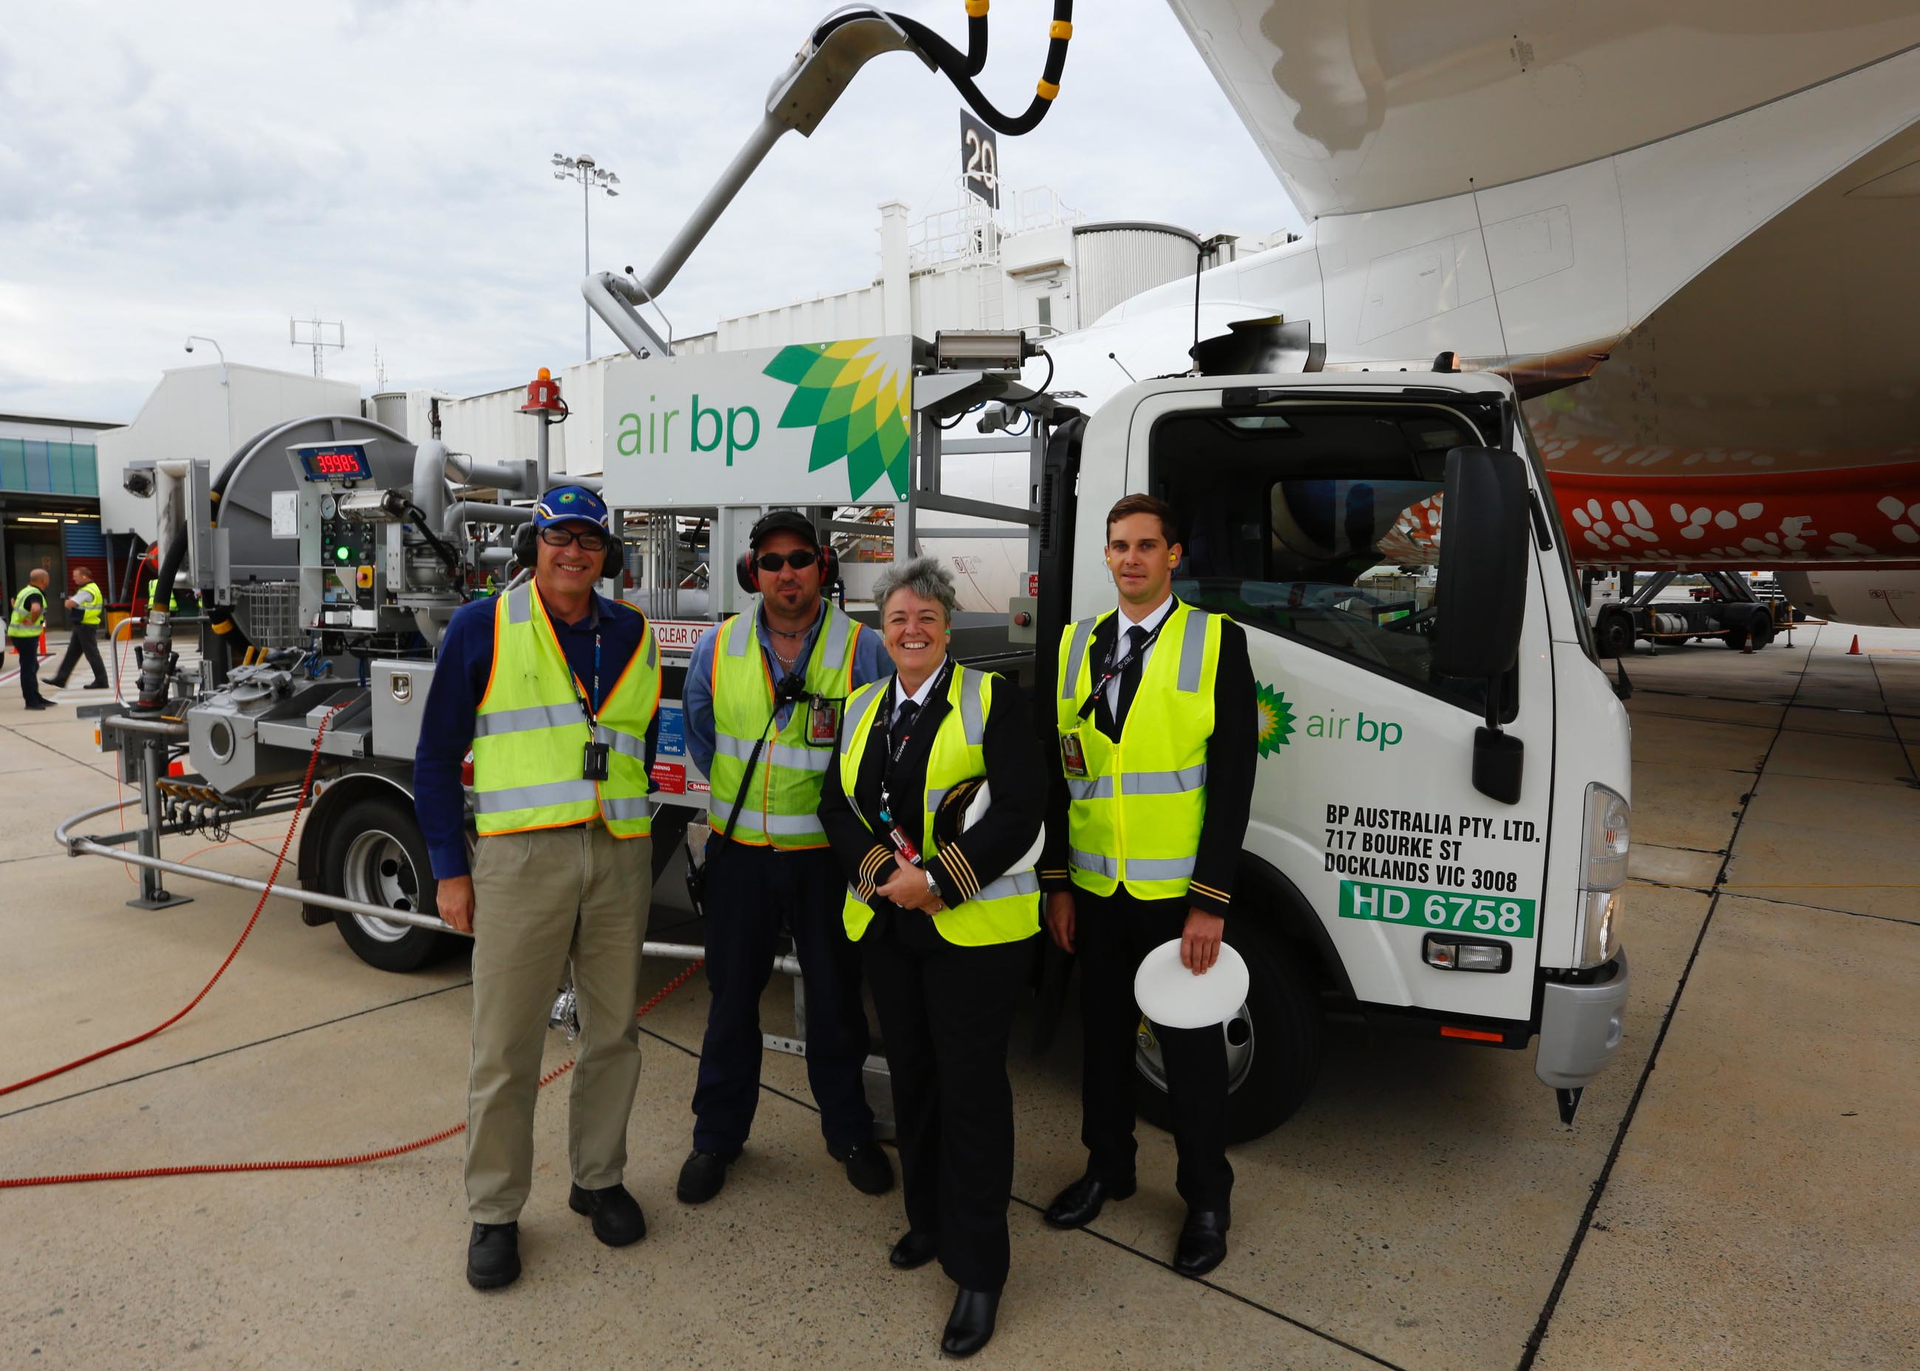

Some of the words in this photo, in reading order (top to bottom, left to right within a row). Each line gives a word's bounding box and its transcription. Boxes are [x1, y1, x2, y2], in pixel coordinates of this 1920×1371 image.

[966, 128, 995, 190] 20
[617, 395, 679, 456] air
[691, 394, 760, 467] bp
[316, 454, 360, 473] 39985
[659, 626, 687, 644] CLEAR
[1306, 708, 1350, 739] air
[1356, 712, 1403, 751] bp
[1326, 804, 1349, 824] BP
[1354, 807, 1452, 835] AUSTRALIA
[1459, 816, 1496, 839] PTY.
[1503, 820, 1540, 842] LTD.
[1325, 828, 1356, 850] 717
[1362, 832, 1433, 858] BOURKE
[1439, 840, 1462, 861] ST
[1325, 852, 1429, 883] DOCKLANDS
[1436, 865, 1465, 887] VIC
[1471, 869, 1517, 892] 3008
[1353, 885, 1410, 919] HD
[1424, 895, 1521, 933] 6758
